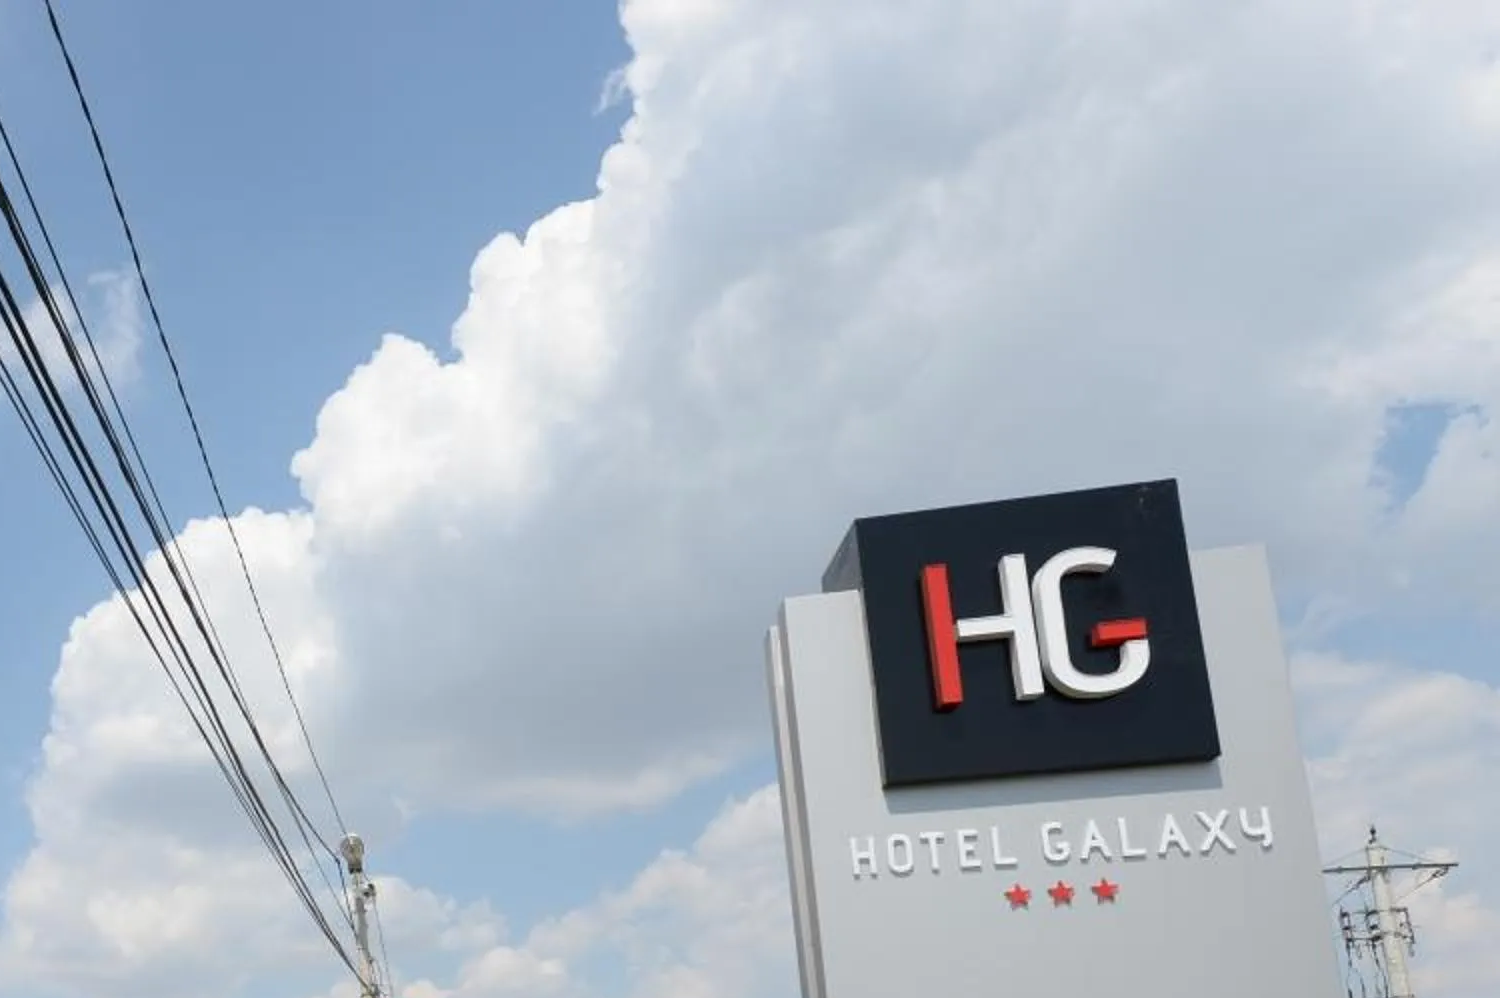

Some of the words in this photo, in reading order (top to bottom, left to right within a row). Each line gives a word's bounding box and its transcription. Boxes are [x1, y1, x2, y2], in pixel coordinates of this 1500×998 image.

[920, 545, 1151, 711] HG
[848, 826, 1019, 880] HOTEL
[1040, 806, 1274, 863] GALAXY
